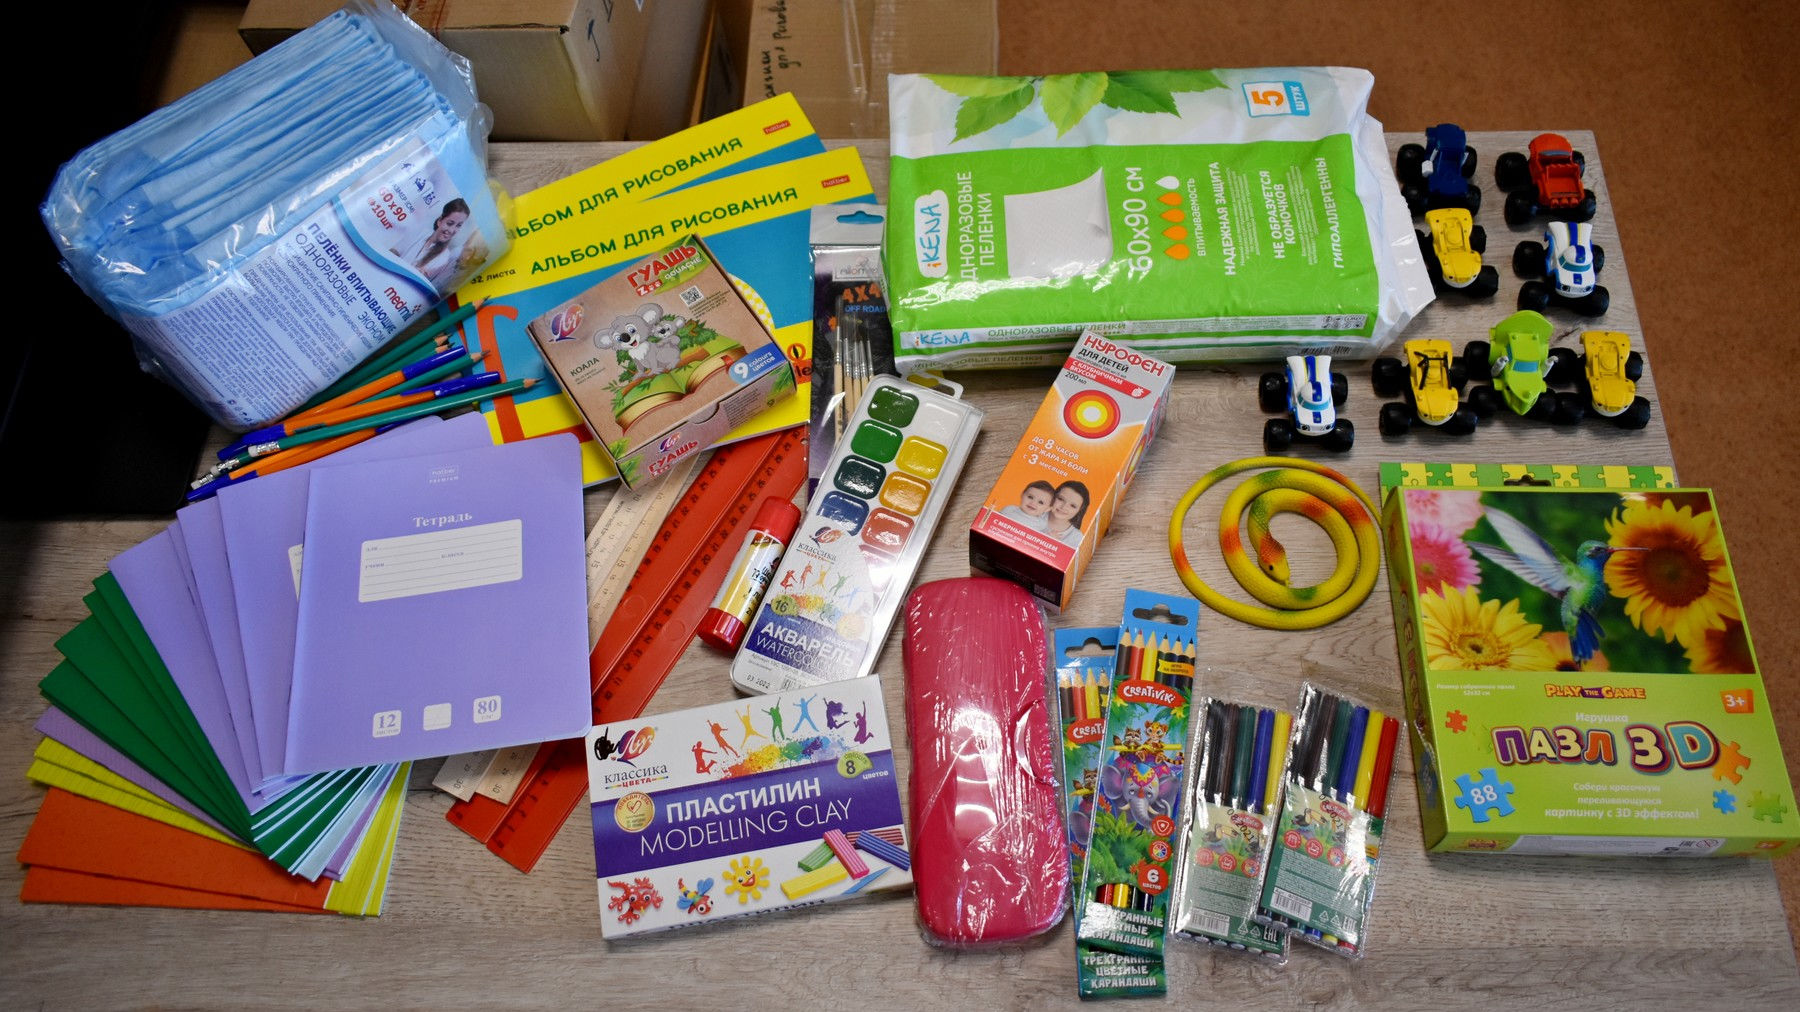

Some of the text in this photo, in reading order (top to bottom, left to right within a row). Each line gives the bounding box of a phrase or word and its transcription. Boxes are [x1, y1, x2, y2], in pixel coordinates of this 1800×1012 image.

[1251, 86, 1307, 111] 5 ШТУК
[579, 187, 618, 215] ДЛЯ
[623, 137, 743, 194] РИСОВАНИЯ
[1186, 178, 1206, 257] впитываемость
[1209, 161, 1237, 276] НАДЕЖНАЯ ЗАЩИТА
[1259, 170, 1286, 259] НЕ ОБРАЗУЕТСЯ
[1276, 184, 1296, 245] КОМОЧКОВ
[1315, 157, 1345, 269] ГИПОАЛЛЕРГЕННЫ
[531, 188, 798, 275] АЛЬБОМ ДЛЯ РИСОВАНИЯ
[920, 203, 943, 268] iKENA
[957, 171, 978, 283] ДНОРАЗОВЫЕ
[977, 193, 995, 266] ПЕЛЕНКИ
[295, 233, 357, 306] ОДНОРАЗОВЫЕ
[487, 268, 517, 281] листа
[627, 244, 697, 288] ГУАШЬ
[307, 223, 397, 335] ПЕЛЁНКИ ВПИТЫВАЮЩИЕ
[842, 281, 882, 304] 4X4
[914, 331, 970, 348] iKENA
[988, 326, 1072, 338] ОДНОРАЗОВЫЕ
[570, 356, 601, 378] КОАЛА
[734, 351, 773, 378] 9 colours
[1078, 348, 1098, 363] ДЛЯ
[1098, 355, 1130, 373] ДЕТЕЙ
[1084, 335, 1166, 377] НУРОФЕН
[1064, 371, 1079, 383] 200
[1069, 365, 1098, 381] ВКУСОМ
[648, 440, 698, 472] ГУАШЬ
[1045, 439, 1055, 451] 8
[1028, 445, 1040, 454] ОТ
[1067, 460, 1089, 475] БОЛИ
[1028, 454, 1039, 466] 3
[413, 511, 473, 528] Тетрадь
[775, 599, 789, 613] 16
[761, 621, 854, 667] АКВАРЕЛЬ
[1545, 684, 1582, 698] PLAY
[1601, 686, 1646, 699] GAME
[1725, 694, 1745, 708] 3+
[477, 698, 498, 715] 80
[377, 713, 397, 729] 12
[1575, 712, 1629, 724] Игрушка
[1492, 721, 1721, 775] ПАЗЛ 3D
[604, 763, 668, 784] классика
[846, 760, 889, 781] 8 цветов
[622, 777, 652, 788] ЦВЕТА
[666, 777, 821, 823] ПЛАСТИЛИН
[1470, 785, 1498, 805] 88
[1545, 808, 1604, 820] картинку
[1615, 808, 1631, 818] 3D
[1634, 808, 1700, 821] эффектом!
[641, 811, 788, 856] MODELLING
[795, 798, 852, 827] CLAY
[1146, 868, 1160, 883] 6
[1097, 907, 1164, 928] ГРАННЫЕ
[1096, 965, 1149, 977] ЦВЕТНЫЕ
[1091, 977, 1157, 989] КАРАНДАШИ
